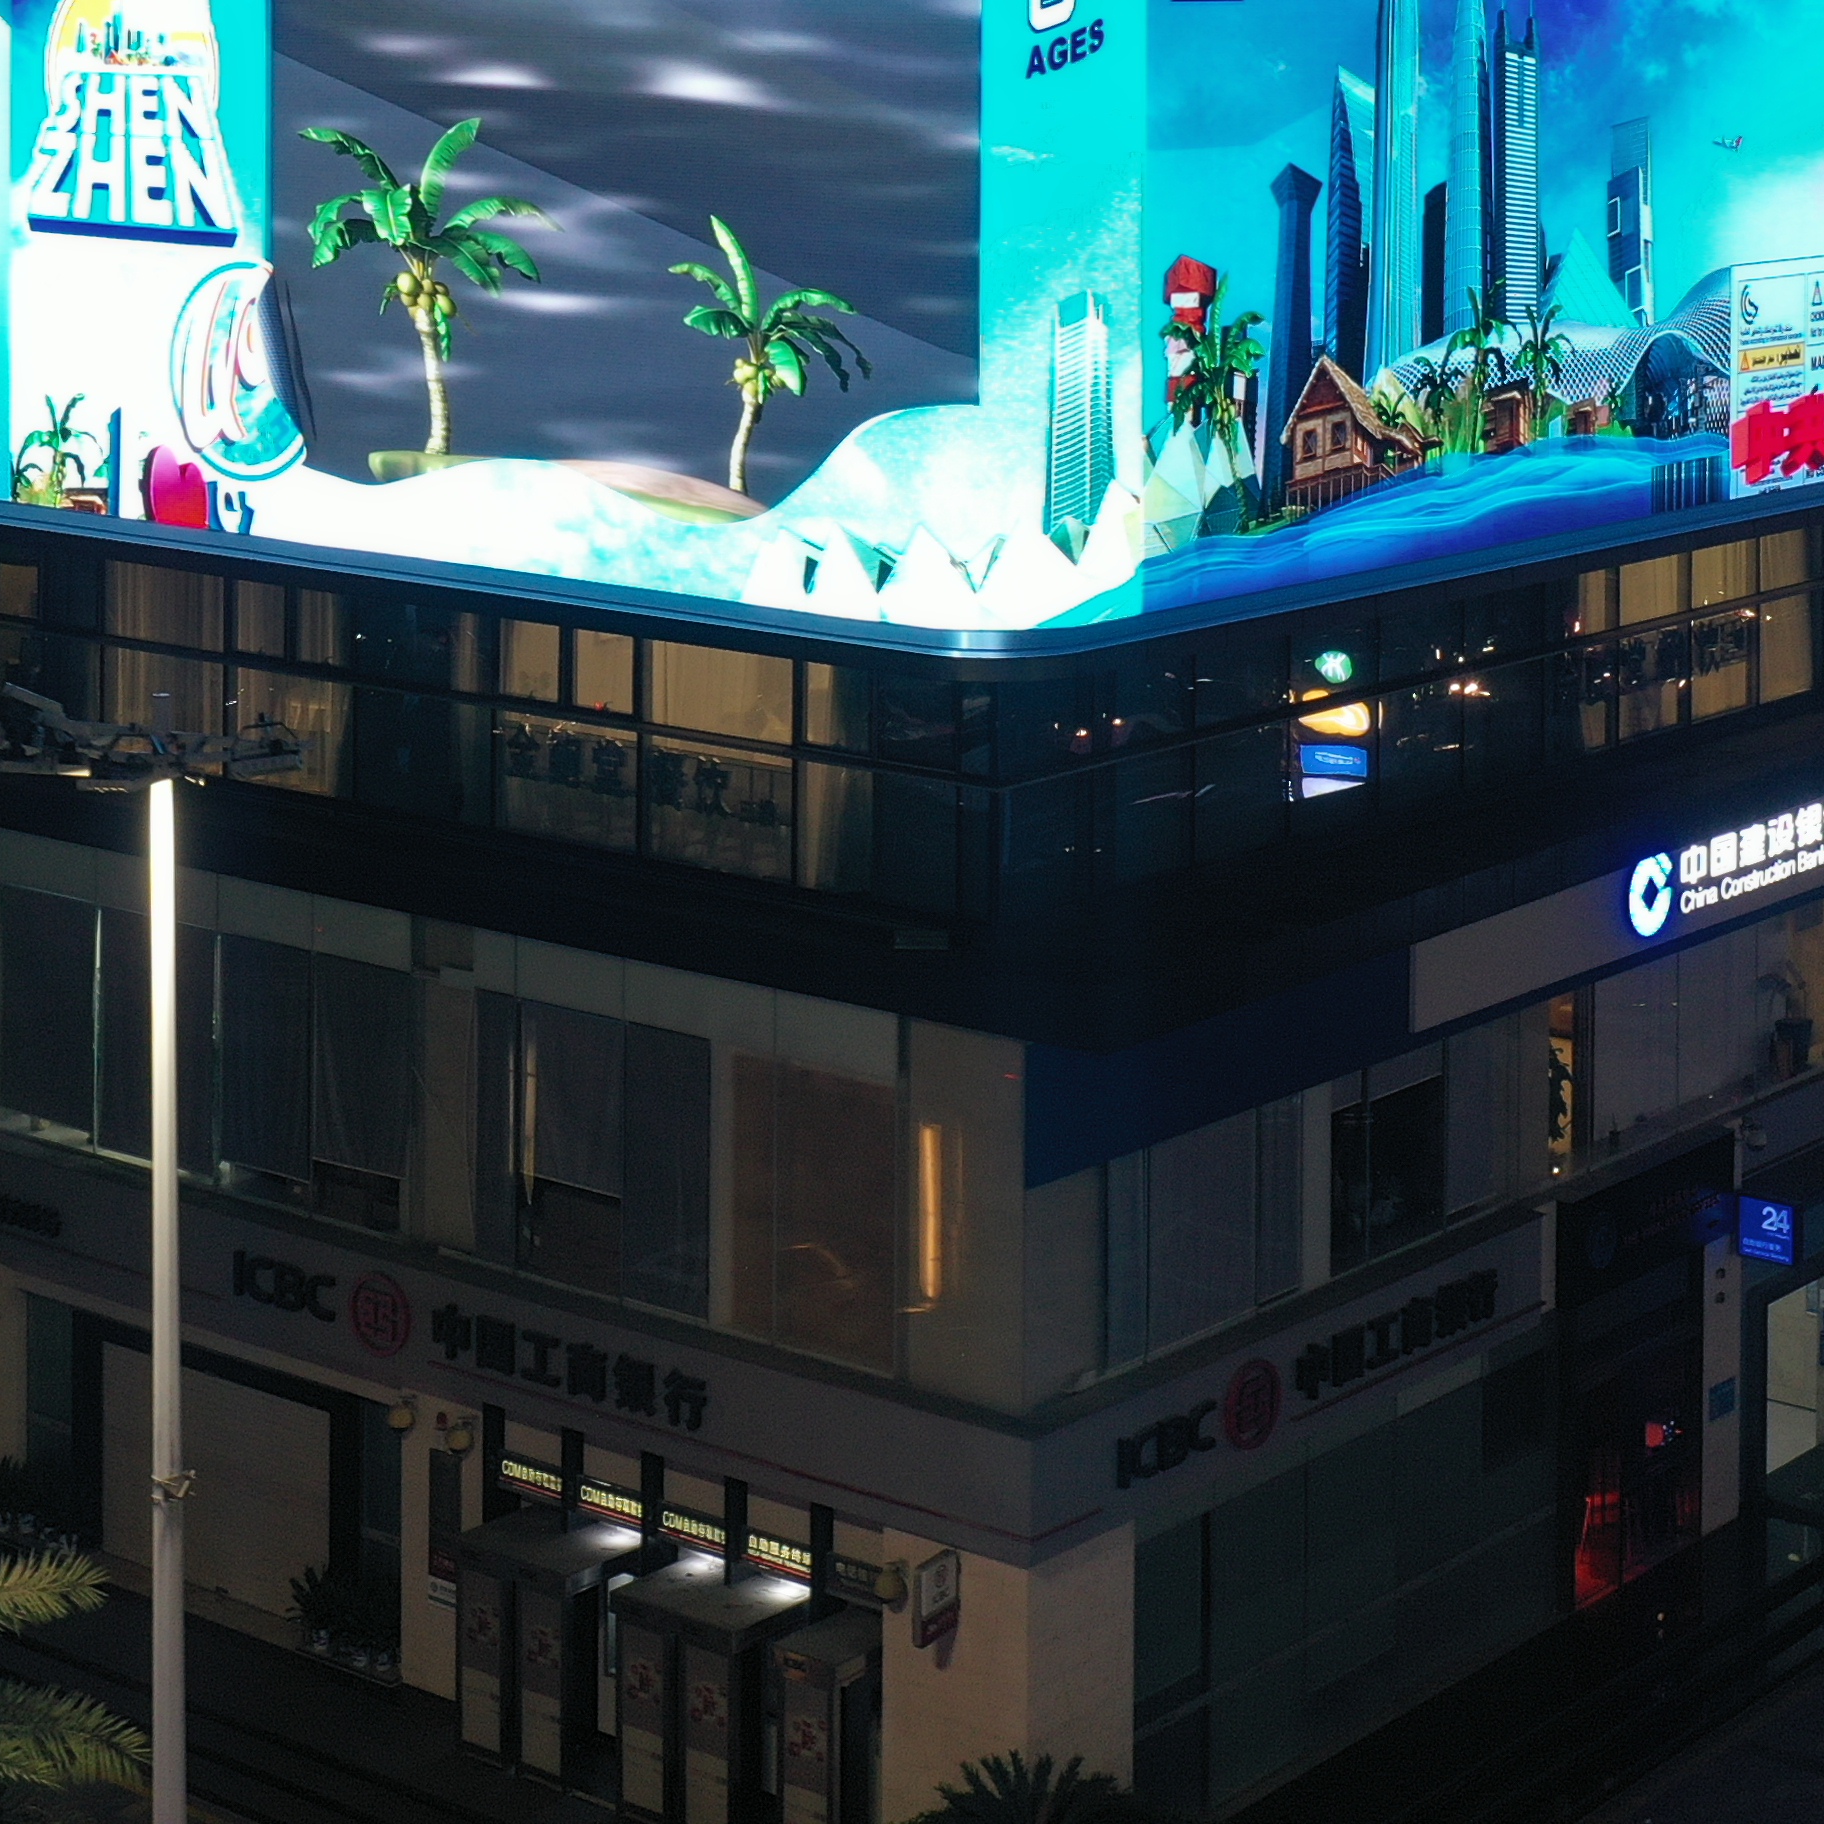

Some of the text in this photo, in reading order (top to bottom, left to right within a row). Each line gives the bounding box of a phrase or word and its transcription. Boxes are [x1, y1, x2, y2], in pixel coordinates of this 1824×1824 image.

[1026, 19, 1105, 79] AGES
[52, 72, 218, 140] SHEN
[28, 132, 238, 230] ZHEN
[1680, 886, 1718, 914] China
[1721, 859, 1796, 900] Construction
[1761, 1206, 1791, 1234] 24
[233, 1250, 707, 1432] ICBC 中国工商银行
[1117, 1399, 1217, 1489] ICBC
